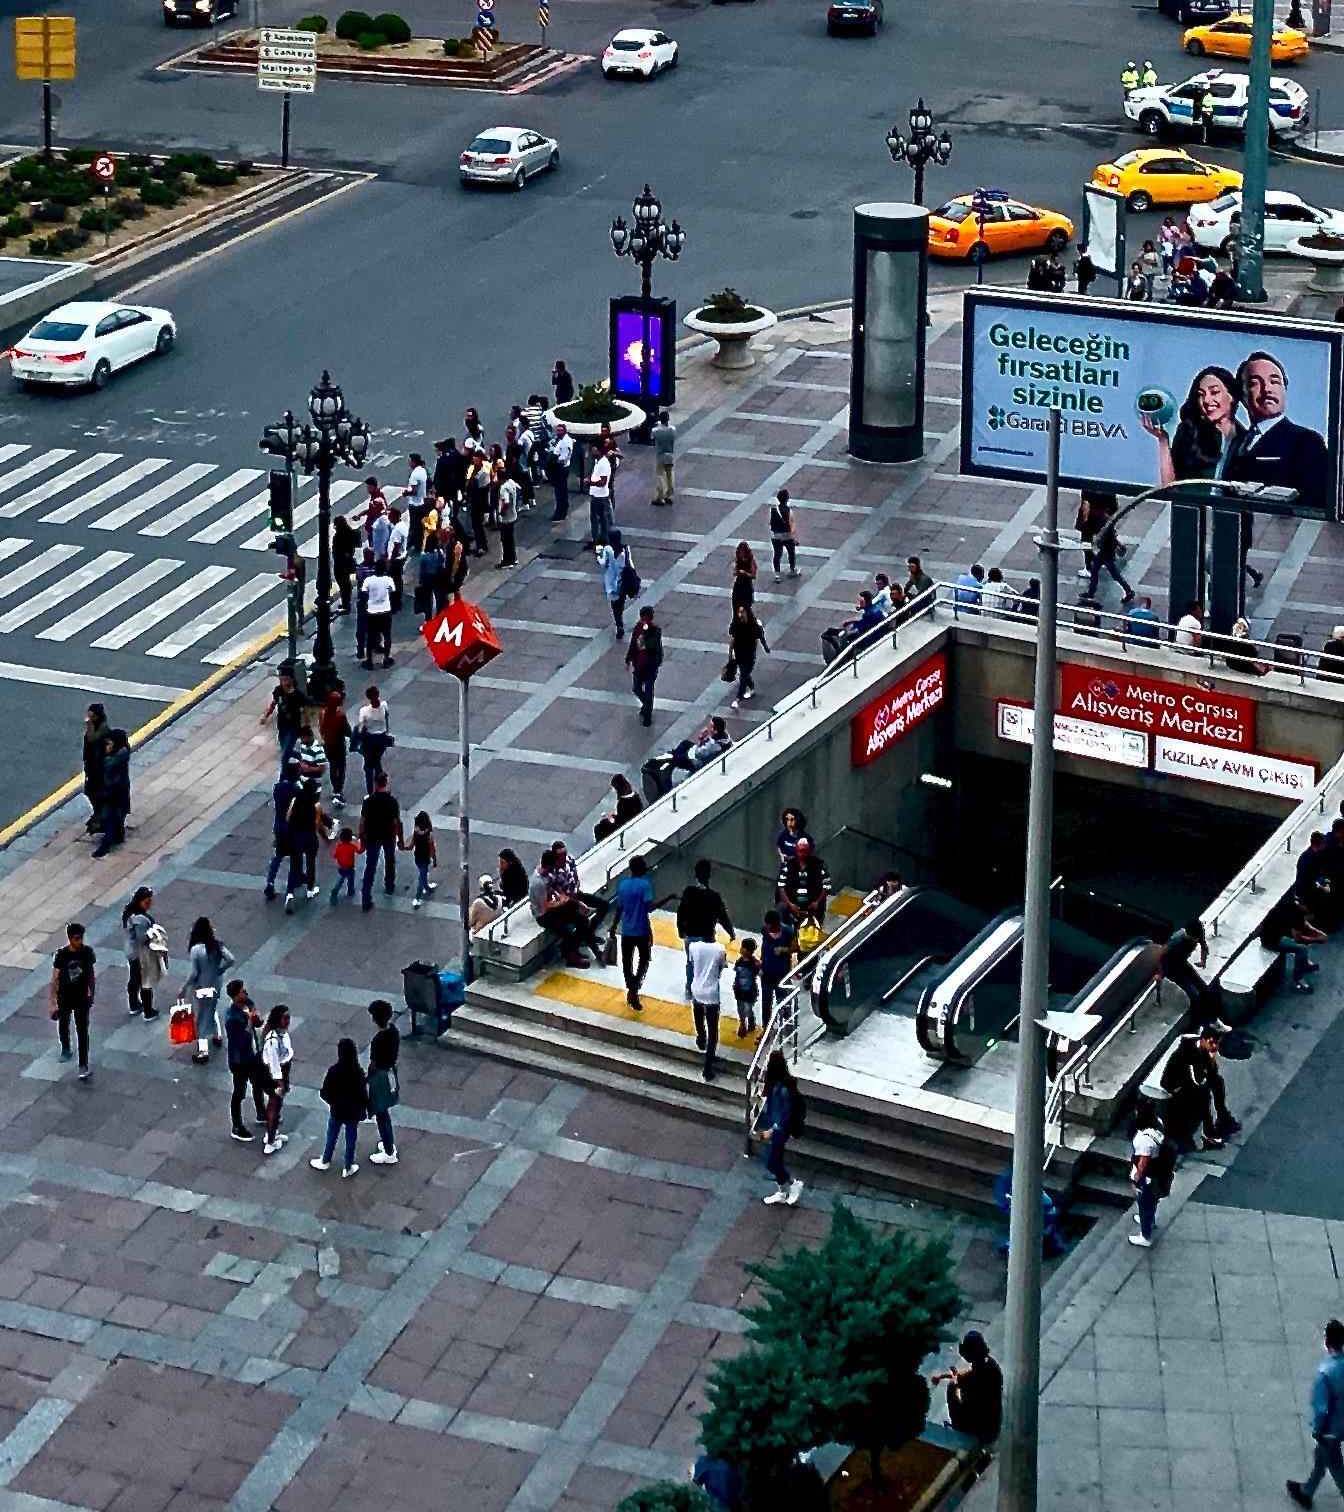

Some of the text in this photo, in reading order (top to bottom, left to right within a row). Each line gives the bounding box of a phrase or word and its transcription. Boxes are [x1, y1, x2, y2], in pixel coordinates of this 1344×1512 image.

[988, 323, 1131, 363] Geleceğin
[998, 352, 1120, 388] fırsatları
[1012, 383, 1104, 414] sizinle
[1006, 410, 1128, 440] Garai BBVA
[434, 617, 464, 646] M
[866, 680, 943, 756] Alışveriş Merkezi
[892, 689, 915, 714] Metro
[1071, 692, 1244, 743] Alışveriş Merkezi
[1126, 684, 1239, 720] Metro Çarşısı
[1162, 748, 1305, 790] KIZILAY AVM ÇIKIŞI
